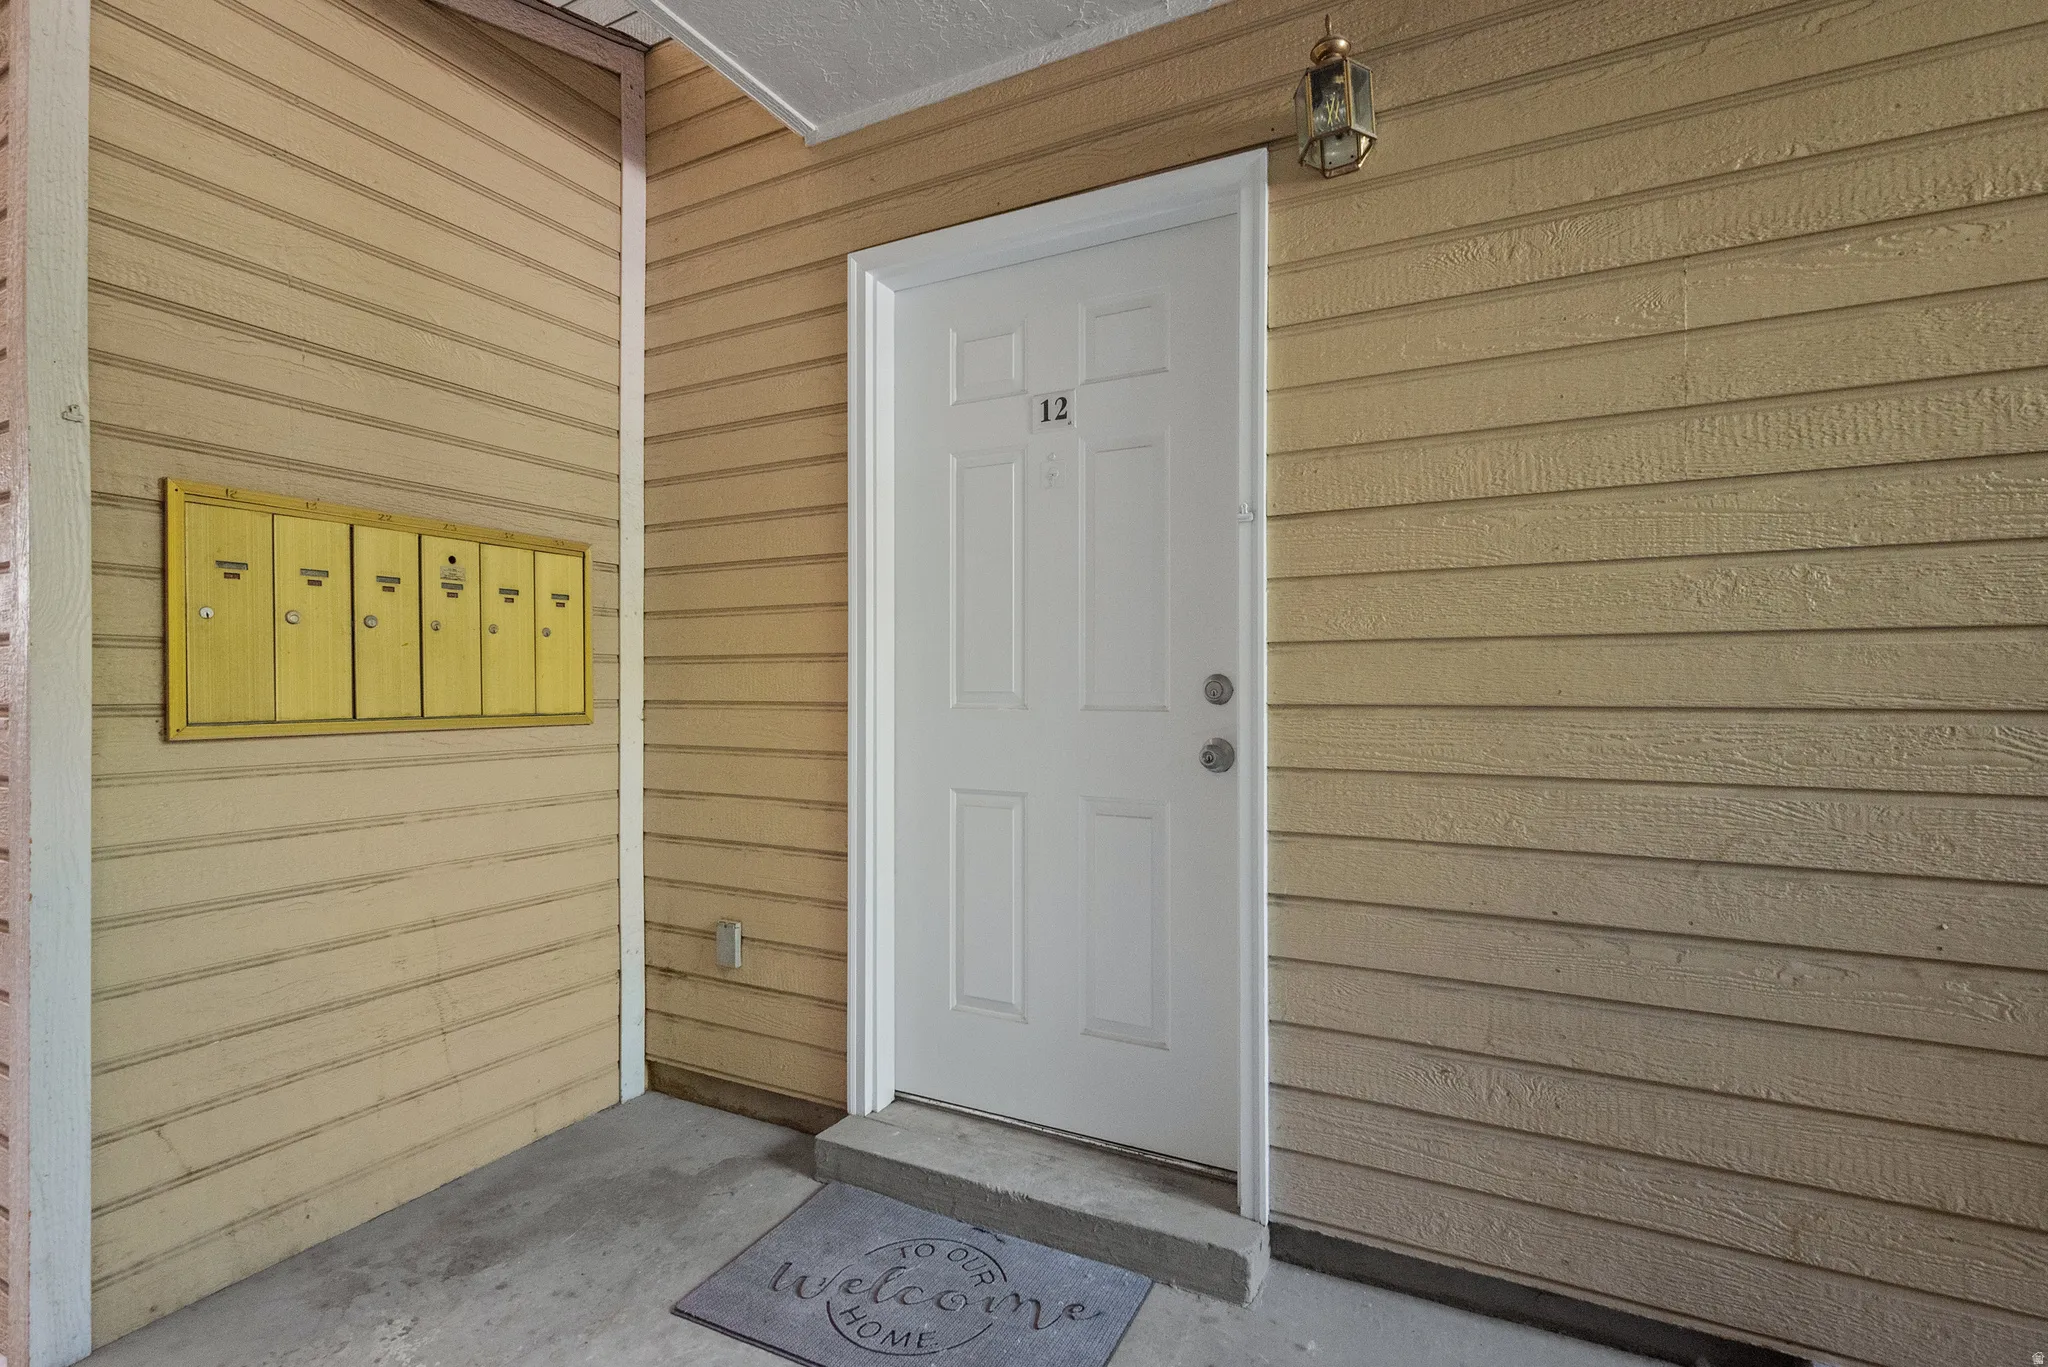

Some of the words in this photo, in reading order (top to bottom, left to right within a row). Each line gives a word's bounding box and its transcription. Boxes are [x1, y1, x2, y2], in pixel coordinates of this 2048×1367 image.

[1040, 396, 1068, 423] 12
[225, 488, 238, 499] 12
[377, 513, 392, 522] 22
[899, 1243, 936, 1259] TO
[947, 1248, 995, 1287] OUR
[838, 1305, 939, 1349] HOME
